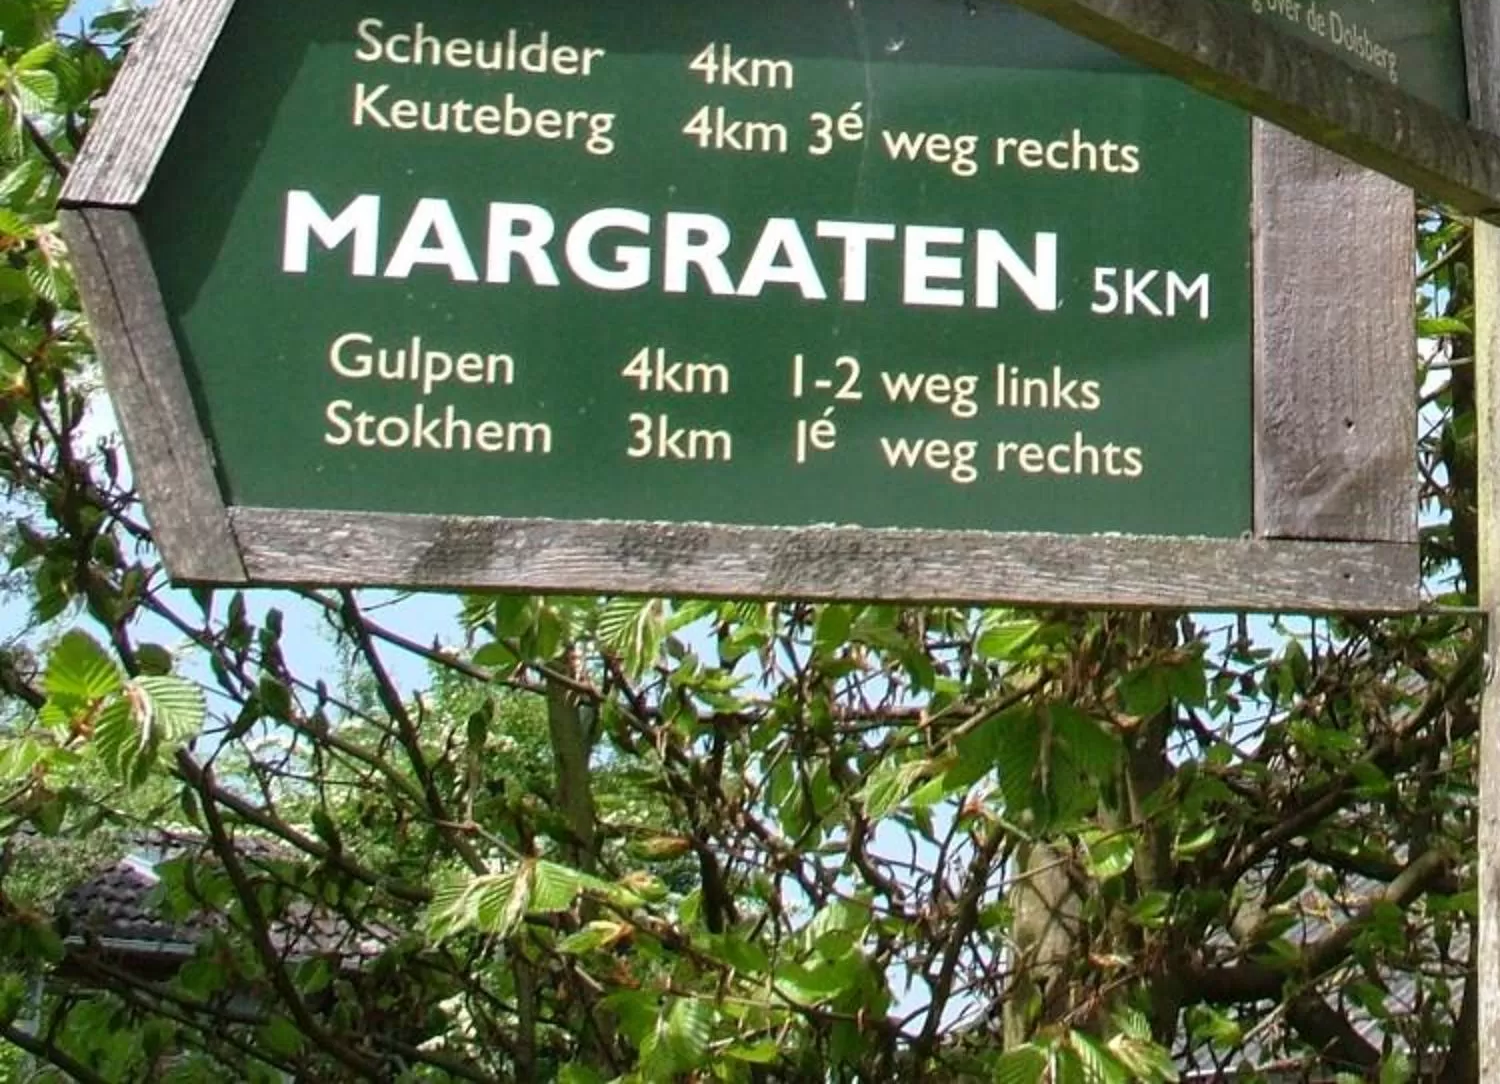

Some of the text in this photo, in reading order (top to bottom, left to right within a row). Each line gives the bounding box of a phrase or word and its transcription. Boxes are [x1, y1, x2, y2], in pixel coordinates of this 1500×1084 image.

[354, 18, 794, 89] Scheulder 4km
[1306, 0, 1325, 37] de
[1329, 9, 1399, 84] Dolsberg
[352, 83, 1140, 177] Keuteberg 4km 3é weg rechts
[282, 189, 1210, 320] MARGRATEN 5KM
[329, 332, 515, 395] Gulpen
[621, 346, 730, 394] 4km
[881, 370, 979, 419] weg
[996, 363, 1101, 411] links
[324, 399, 553, 453] Stokhem
[626, 412, 733, 461] 3km
[880, 436, 978, 484] weg
[997, 430, 1143, 477] rechts
